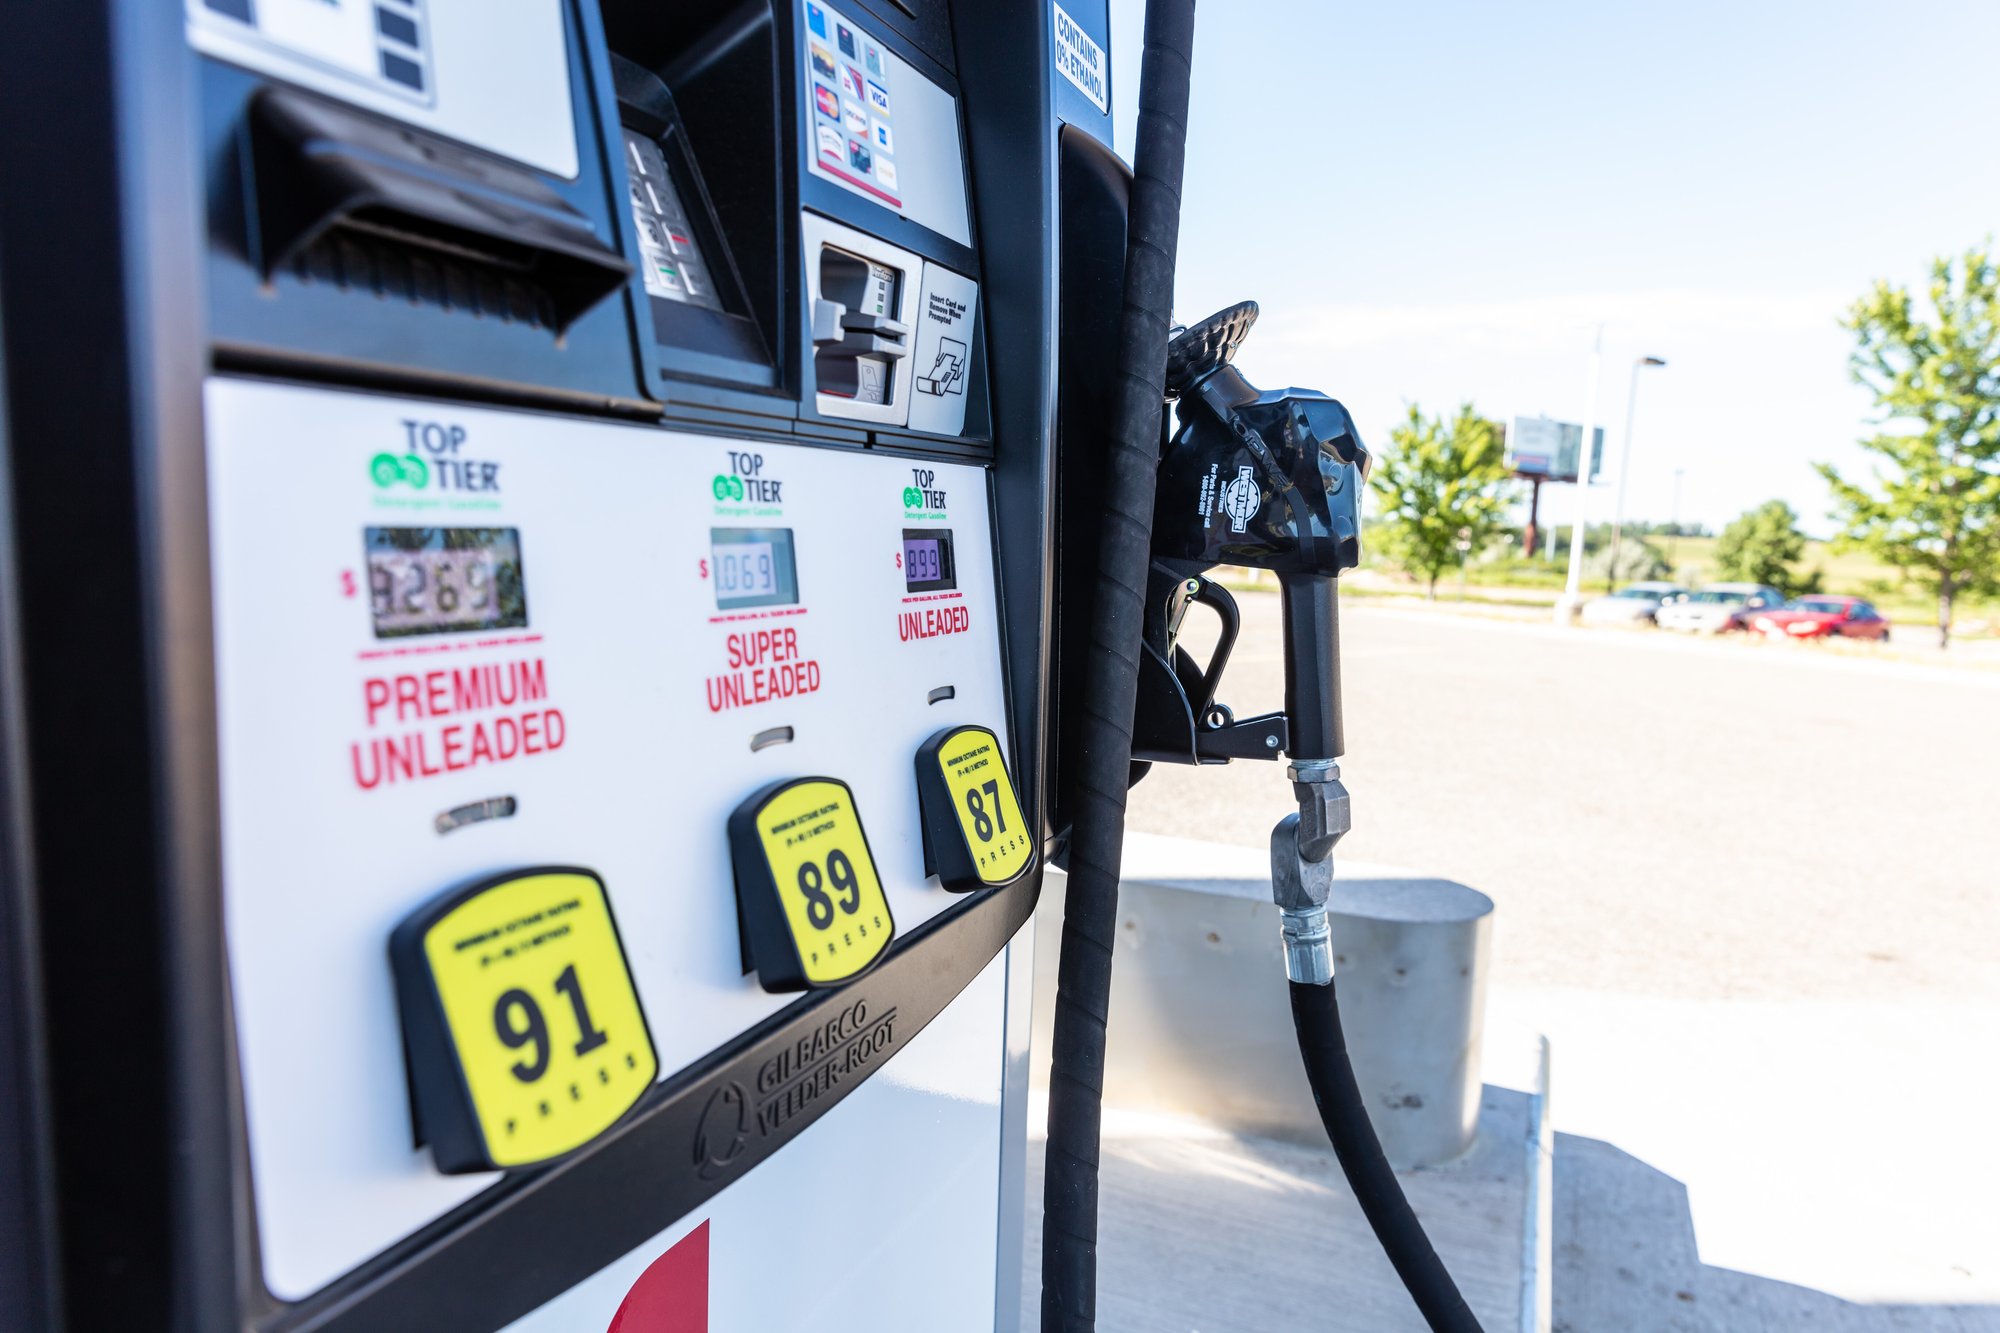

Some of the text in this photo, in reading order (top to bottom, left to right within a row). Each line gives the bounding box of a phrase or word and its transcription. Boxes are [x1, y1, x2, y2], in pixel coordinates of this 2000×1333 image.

[1058, 13, 1098, 71] CONTAINS
[1056, 40, 1104, 102] 0% ETHANOL
[871, 89, 888, 109] VISA
[928, 310, 952, 325] Prompted
[930, 292, 966, 312] Insert Card and
[930, 301, 962, 320] Remove When
[402, 420, 466, 454] TOP
[434, 459, 500, 492] TIER
[728, 452, 763, 476] TOP
[912, 468, 934, 488] TOP
[745, 479, 782, 503] TIER
[1209, 474, 1217, 490] Parts
[922, 490, 946, 509] TIER
[1206, 496, 1214, 517] Service
[1234, 470, 1250, 530] WESTMOR
[698, 558, 708, 579] $
[896, 552, 902, 568] $
[341, 569, 358, 599] $
[898, 606, 969, 642] UNLEADED
[727, 628, 798, 669] SUPER
[365, 659, 548, 726] PREMIUM
[706, 660, 820, 712] UNLEADED
[351, 708, 566, 791] UNLEADED
[963, 750, 977, 760] OCTANE
[977, 744, 990, 754] RATING
[974, 758, 989, 769] METHOD
[966, 778, 1007, 842] 87
[980, 834, 1025, 868] PRESS
[798, 848, 861, 931] 89
[810, 916, 882, 967] PRESS
[492, 963, 610, 1085] 91
[757, 998, 868, 1094] GILBARCO
[756, 1014, 897, 1136] VEEDER-ROOT
